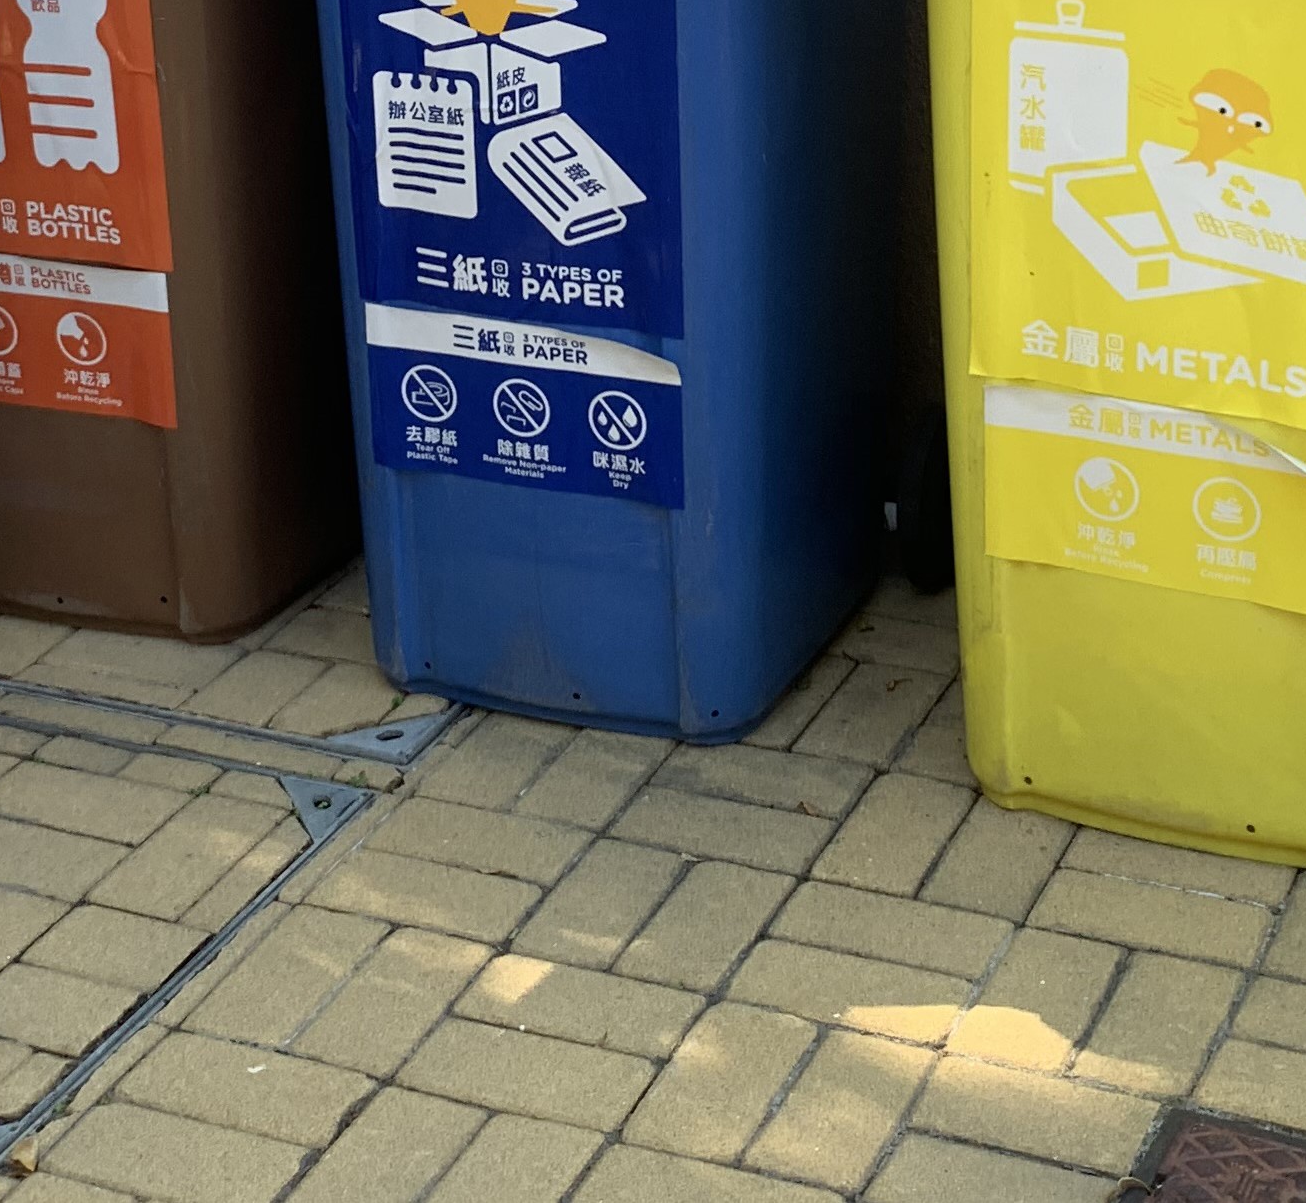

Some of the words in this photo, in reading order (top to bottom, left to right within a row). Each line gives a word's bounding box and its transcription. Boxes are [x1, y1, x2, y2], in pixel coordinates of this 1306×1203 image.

[496, 66, 526, 90] 紙皮
[388, 100, 464, 126] 辦公室紙
[1019, 63, 1046, 152] 汽水罐
[564, 162, 606, 197] 報紙
[26, 201, 113, 226] PLASTIC
[27, 219, 121, 245] BOTTLES
[30, 266, 85, 283] PLASTIC
[522, 262, 531, 276] 3
[536, 264, 591, 281] TYPES
[597, 268, 623, 283] OF
[31, 278, 91, 295] BOTTLES
[522, 278, 625, 308] PAPER
[523, 333, 529, 343] 3
[532, 335, 568, 348] TYPES
[571, 340, 586, 349] OF
[523, 345, 588, 365] PAPER
[64, 368, 111, 388] 沖乾淨
[84, 396, 123, 407] Recycling
[406, 425, 457, 447] 去膠紙
[1149, 418, 1270, 457] METALS
[407, 451, 436, 461] Plastic
[438, 455, 458, 465] Tape
[415, 443, 434, 453] Tear
[436, 446, 450, 454] Off
[497, 439, 549, 462] 除雜質
[483, 454, 517, 467] Remove
[519, 460, 567, 473] Non-paper
[505, 466, 544, 479] Materials
[593, 451, 647, 475] 咪濕水
[608, 471, 632, 482] Keep
[613, 480, 629, 490] Dry
[1078, 522, 1135, 549] 沖乾淨
[1100, 556, 1149, 573] Recycling
